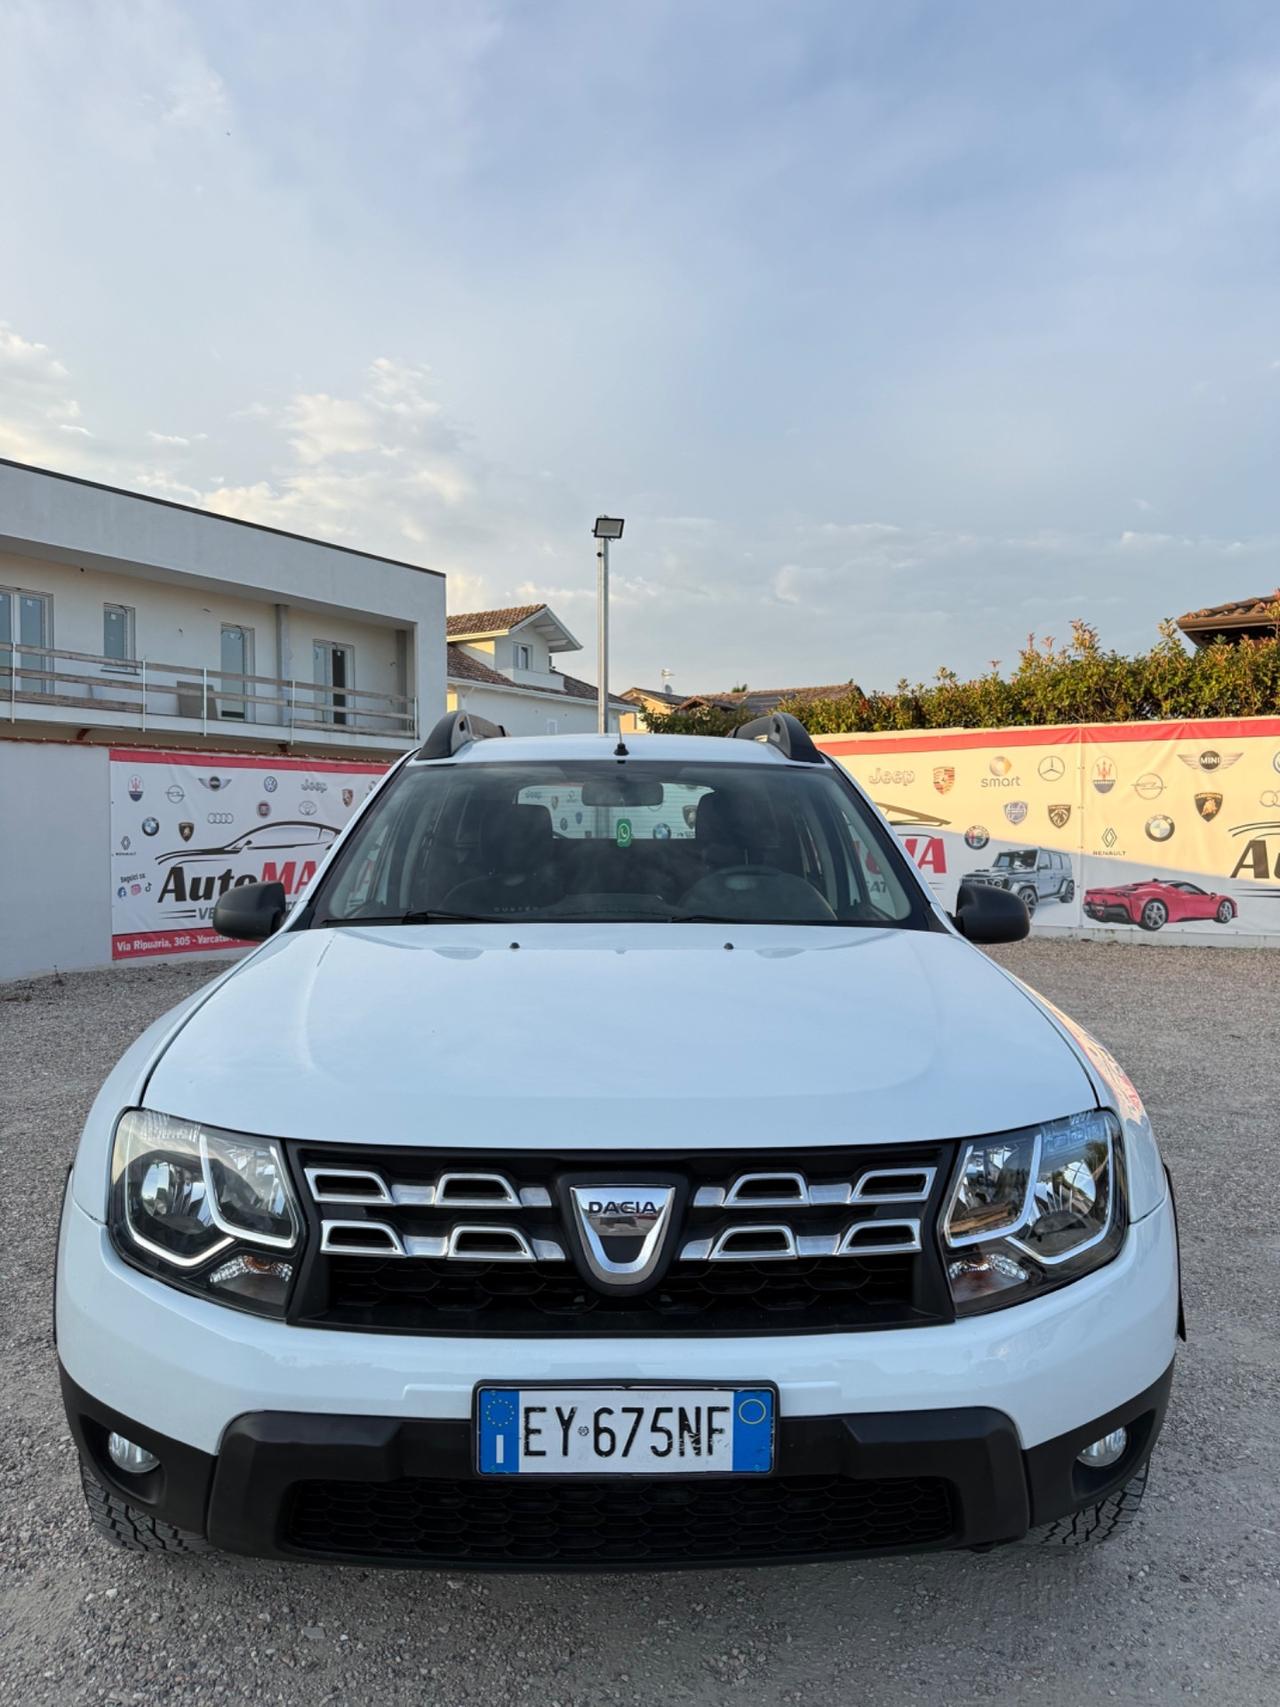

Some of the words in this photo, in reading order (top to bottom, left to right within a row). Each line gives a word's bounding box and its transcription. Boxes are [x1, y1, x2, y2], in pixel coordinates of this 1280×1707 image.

[1200, 756, 1220, 765] MINI
[868, 767, 915, 786] Jeep
[980, 775, 1021, 788] smart
[1230, 839, 1280, 878] A
[117, 942, 130, 951] Via
[174, 936, 190, 946] 305
[588, 1201, 657, 1214] DACIA
